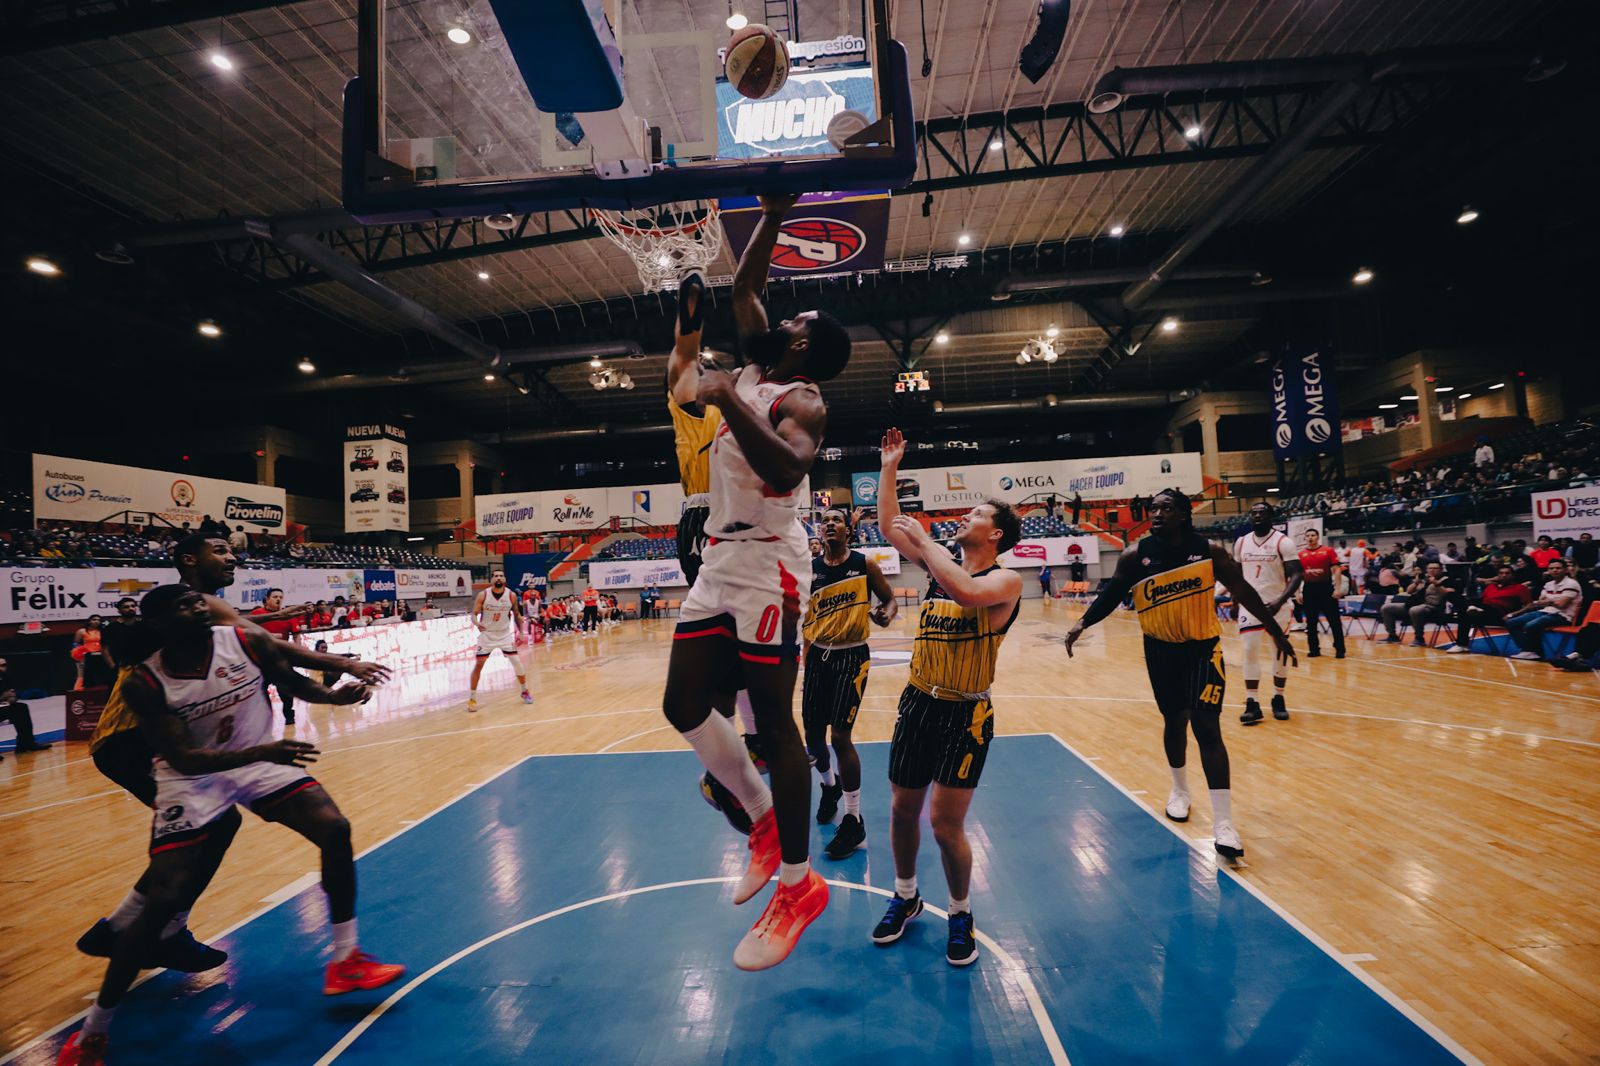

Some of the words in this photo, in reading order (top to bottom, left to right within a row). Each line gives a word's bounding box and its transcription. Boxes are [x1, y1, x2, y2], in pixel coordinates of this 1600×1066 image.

[735, 94, 846, 143] MUCHO
[1302, 352, 1325, 416] MEGA
[347, 425, 381, 437] NUEVA
[384, 423, 406, 439] NUEVA
[354, 448, 374, 460] ZR2
[45, 470, 85, 482] Autobuses
[1015, 475, 1055, 488] MEGA
[1069, 477, 1094, 493] HACER
[1095, 472, 1125, 490] EQUIPO
[88, 489, 132, 504] Premier
[933, 492, 983, 503] D'ESTILO
[225, 504, 282, 521] Provelim
[482, 511, 505, 527] HACER
[506, 506, 534, 524] EQUIPO
[552, 507, 571, 522] Roll
[572, 506, 594, 520] n'Me
[10, 571, 55, 585] Grupo
[611, 573, 631, 586] EQUIPO
[643, 573, 660, 584] HACER
[659, 570, 680, 583] EQUIPO
[1143, 577, 1203, 601] Guasave
[10, 584, 88, 611] Félix
[755, 604, 780, 643] 0
[1200, 683, 1223, 705] 45
